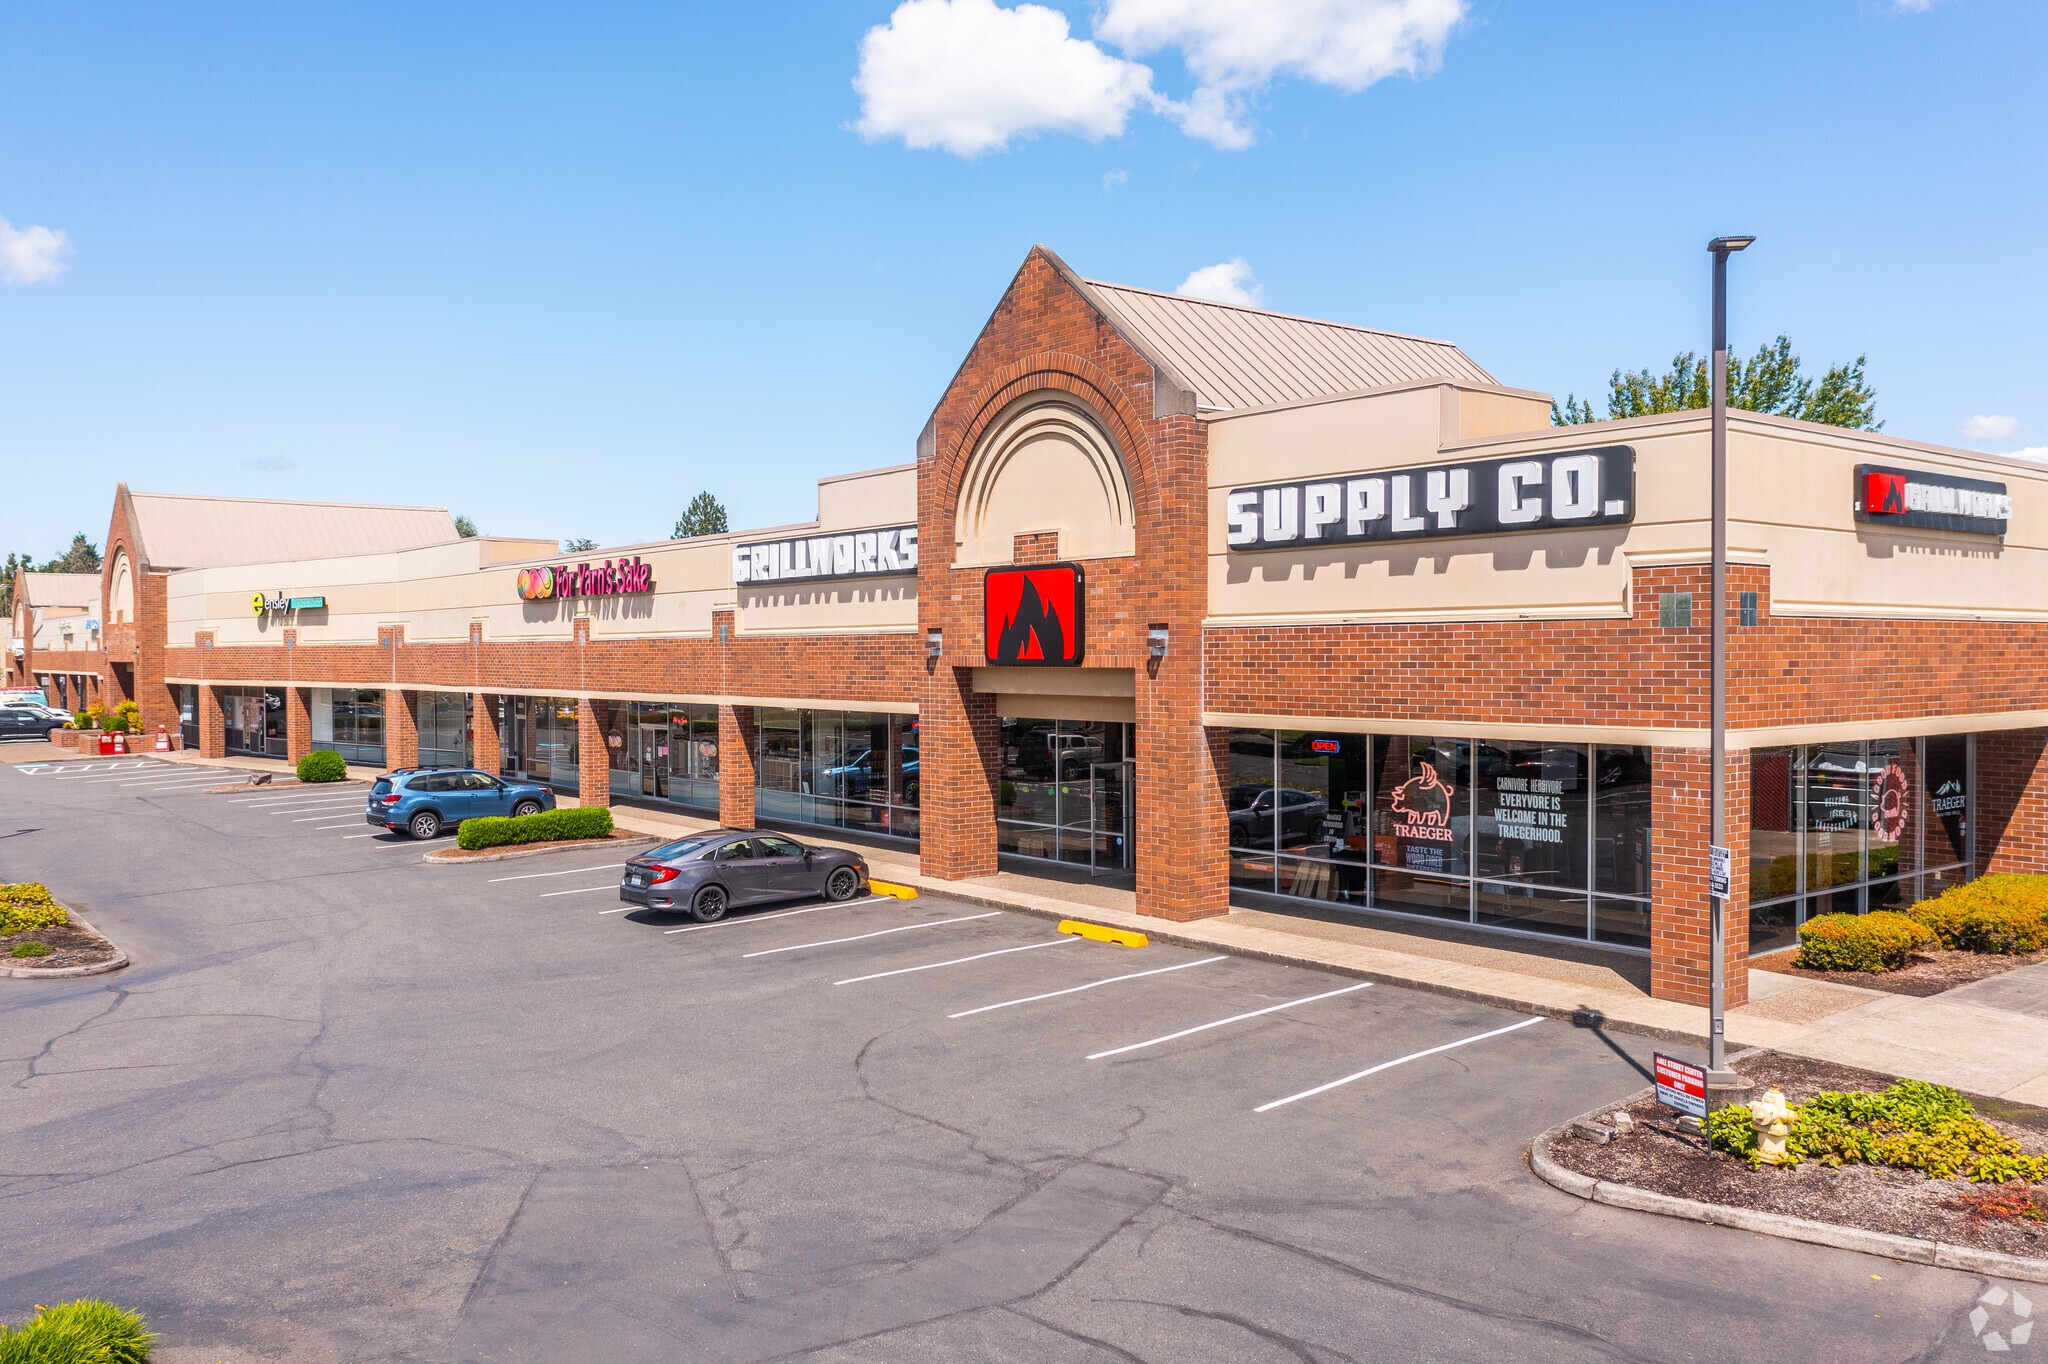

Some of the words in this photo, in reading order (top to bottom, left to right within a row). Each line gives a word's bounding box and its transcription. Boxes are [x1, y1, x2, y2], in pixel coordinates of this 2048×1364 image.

[1227, 468, 1469, 545] SUPPLY
[1498, 454, 1625, 524] CO.
[733, 528, 918, 582] GRILLWORKS
[556, 565, 574, 598] For
[577, 560, 614, 596] Yarn's
[617, 556, 649, 594] Sake
[264, 591, 290, 615] ensley
[1312, 741, 1337, 751] OPEN
[1500, 793, 1550, 810] EVERYVORE
[1551, 796, 1561, 811] IS
[1932, 795, 1965, 811] TRAEGER
[1494, 808, 1537, 825] WELCOME
[1538, 811, 1548, 826] IN
[1549, 813, 1567, 828] THE
[1393, 824, 1454, 842] TRAEGER
[1498, 824, 1563, 843] TRAEGERHOOD.
[1406, 845, 1428, 854] TASTE
[1429, 848, 1443, 856] THE
[1656, 1065, 1681, 1081] CUSTOMER
[1667, 1060, 1684, 1072] STREET
[1684, 1066, 1703, 1079] CENTER
